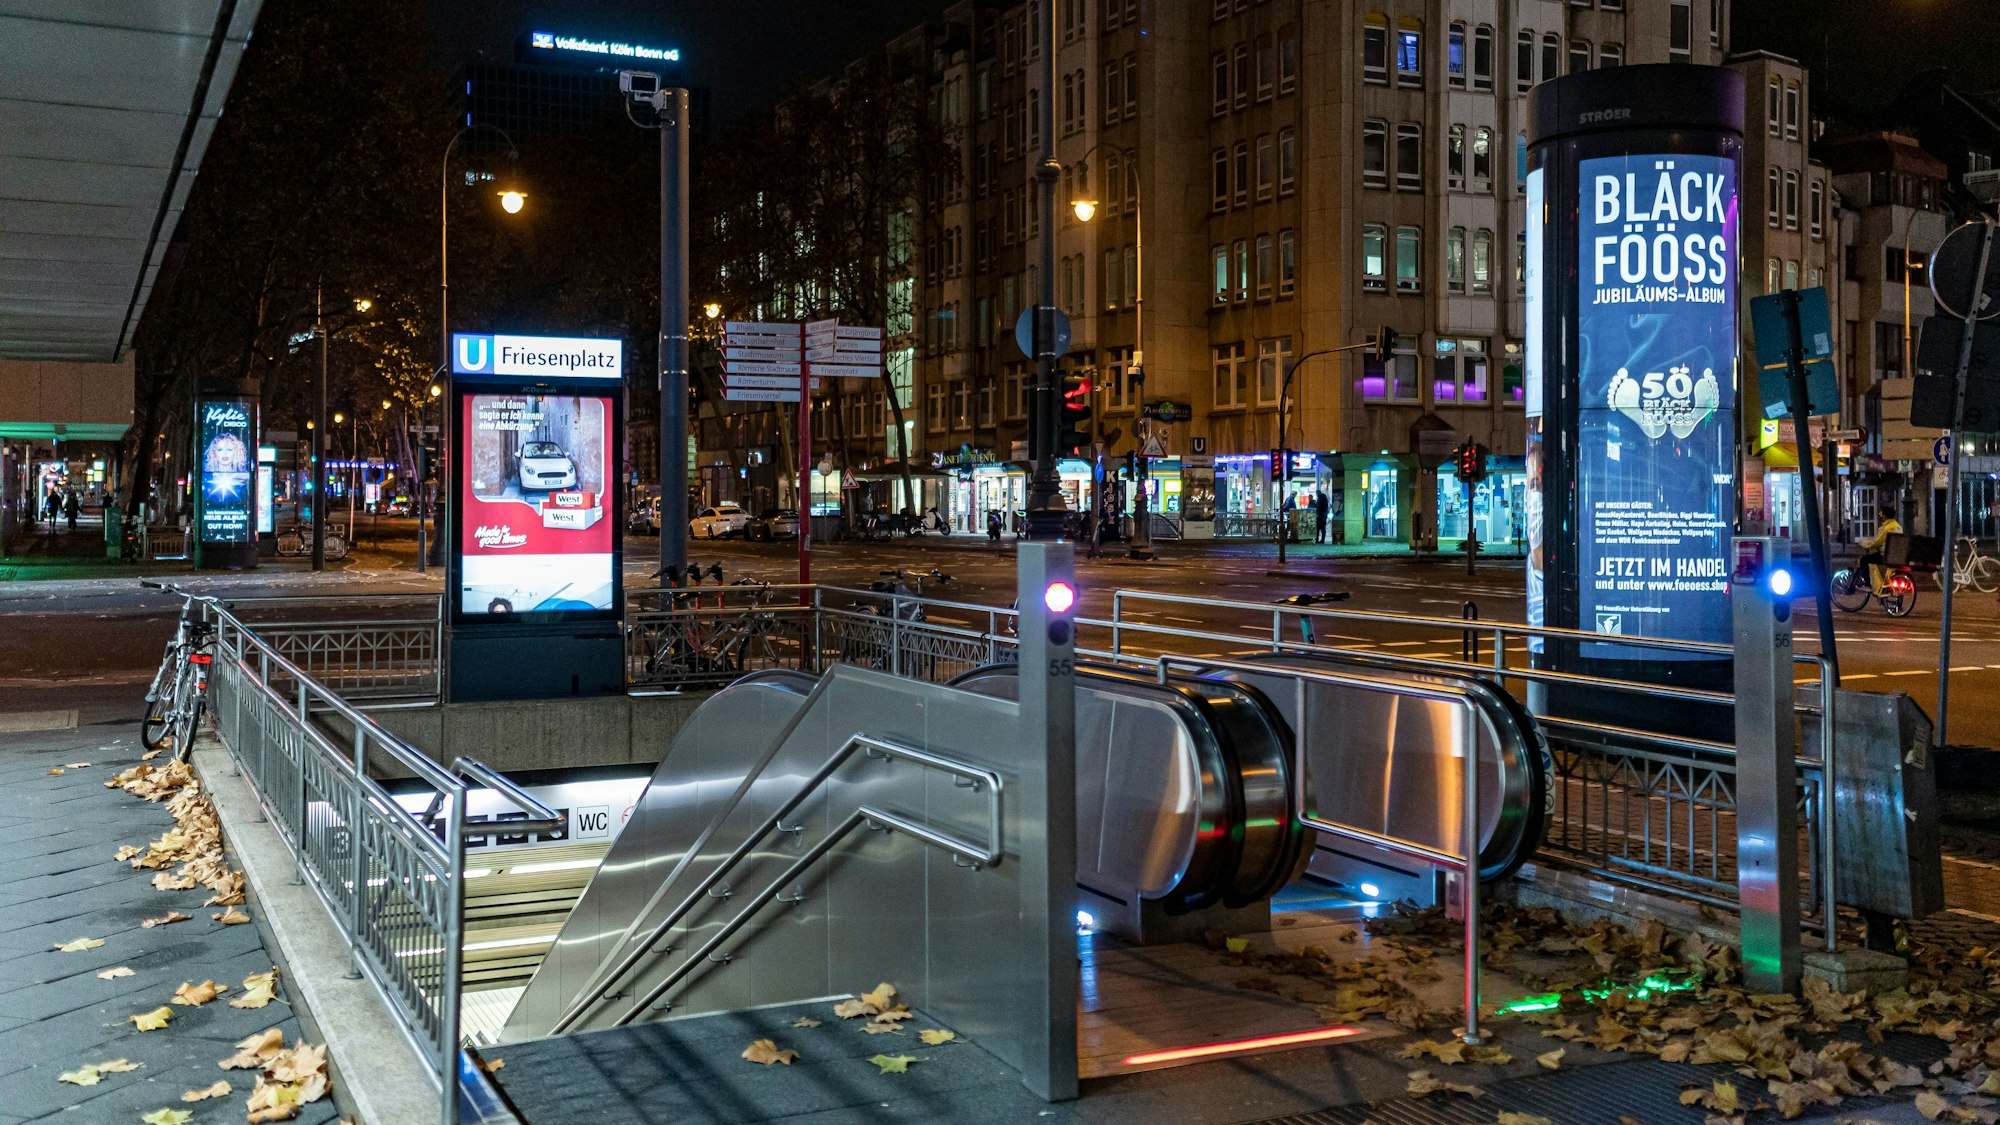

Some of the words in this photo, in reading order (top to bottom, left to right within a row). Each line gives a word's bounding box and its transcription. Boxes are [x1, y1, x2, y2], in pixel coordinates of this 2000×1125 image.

[555, 36, 608, 54] Volksbank
[610, 42, 634, 56] Köln
[635, 46, 662, 60] Bonn
[664, 50, 679, 61] eG
[1595, 161, 1726, 224] BLÄCK
[1595, 223, 1726, 284] FÖÖSS
[1593, 285, 1726, 304] JUBILÄUMS-ALBUM
[845, 328, 880, 338] Grüngürtel
[738, 337, 785, 347] Hauptbahnhof
[460, 338, 488, 371] U
[502, 347, 614, 371] Friesenplatz
[738, 350, 784, 359] Stadtmuseum
[738, 364, 766, 373] Römische
[766, 365, 798, 374] Stadtmauer
[821, 366, 858, 375] Friesenplatz
[738, 378, 776, 386] Römerturm
[738, 391, 781, 400] Friesenviertel
[492, 400, 506, 409] und
[507, 400, 526, 409] dann
[206, 406, 245, 426] Kylie
[479, 411, 500, 422] sagte
[501, 412, 509, 420] er
[510, 411, 522, 420] Ich
[522, 412, 544, 421] kenne
[478, 422, 494, 430] eine
[1195, 440, 1204, 452] U
[960, 472, 971, 480] sky
[558, 495, 580, 504] West
[552, 513, 574, 522] West
[474, 526, 500, 538] Made
[1596, 557, 1646, 577] JETZT
[1651, 558, 1670, 577] IM
[1676, 558, 1728, 578] HANDEL
[1596, 578, 1614, 590] und
[1617, 579, 1646, 591] unter
[1647, 578, 1728, 594] www.foeoess.shop
[1774, 633, 1790, 648] 56
[1050, 660, 1072, 677] 55
[578, 811, 608, 832] WC
